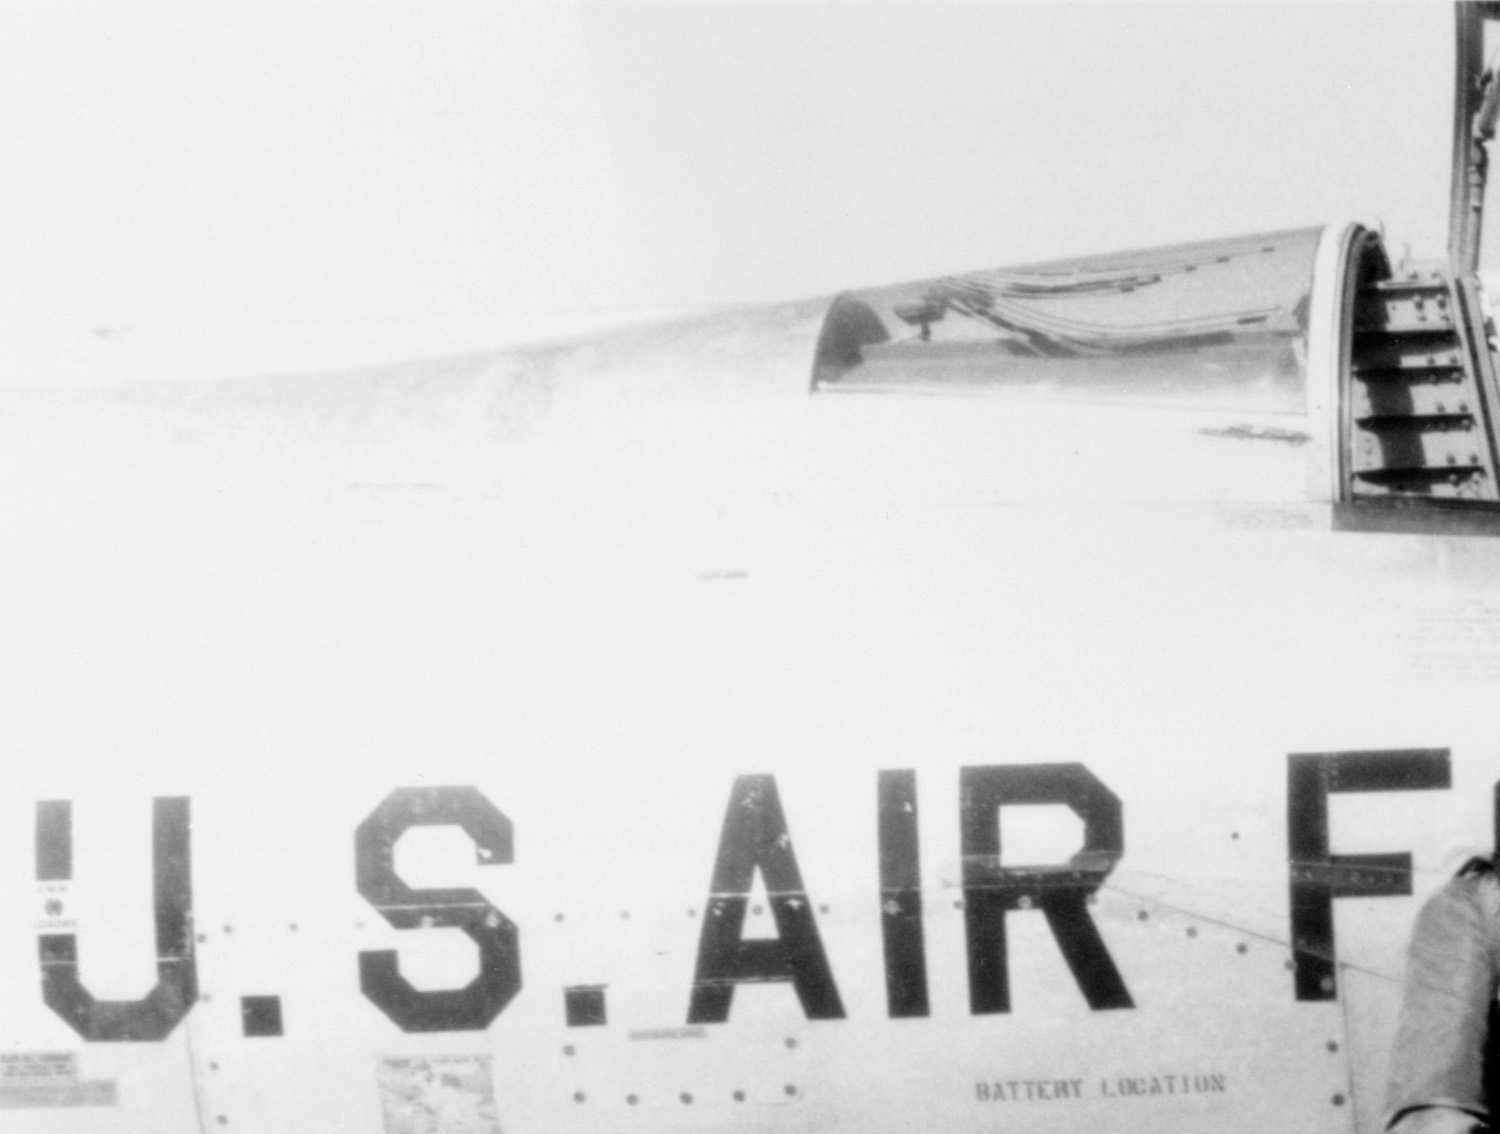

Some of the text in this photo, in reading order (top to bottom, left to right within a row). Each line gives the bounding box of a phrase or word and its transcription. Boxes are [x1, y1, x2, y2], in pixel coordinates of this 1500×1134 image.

[688, 762, 1136, 1024] AIR
[975, 1073, 1226, 1102] BATTERY LOCATION
